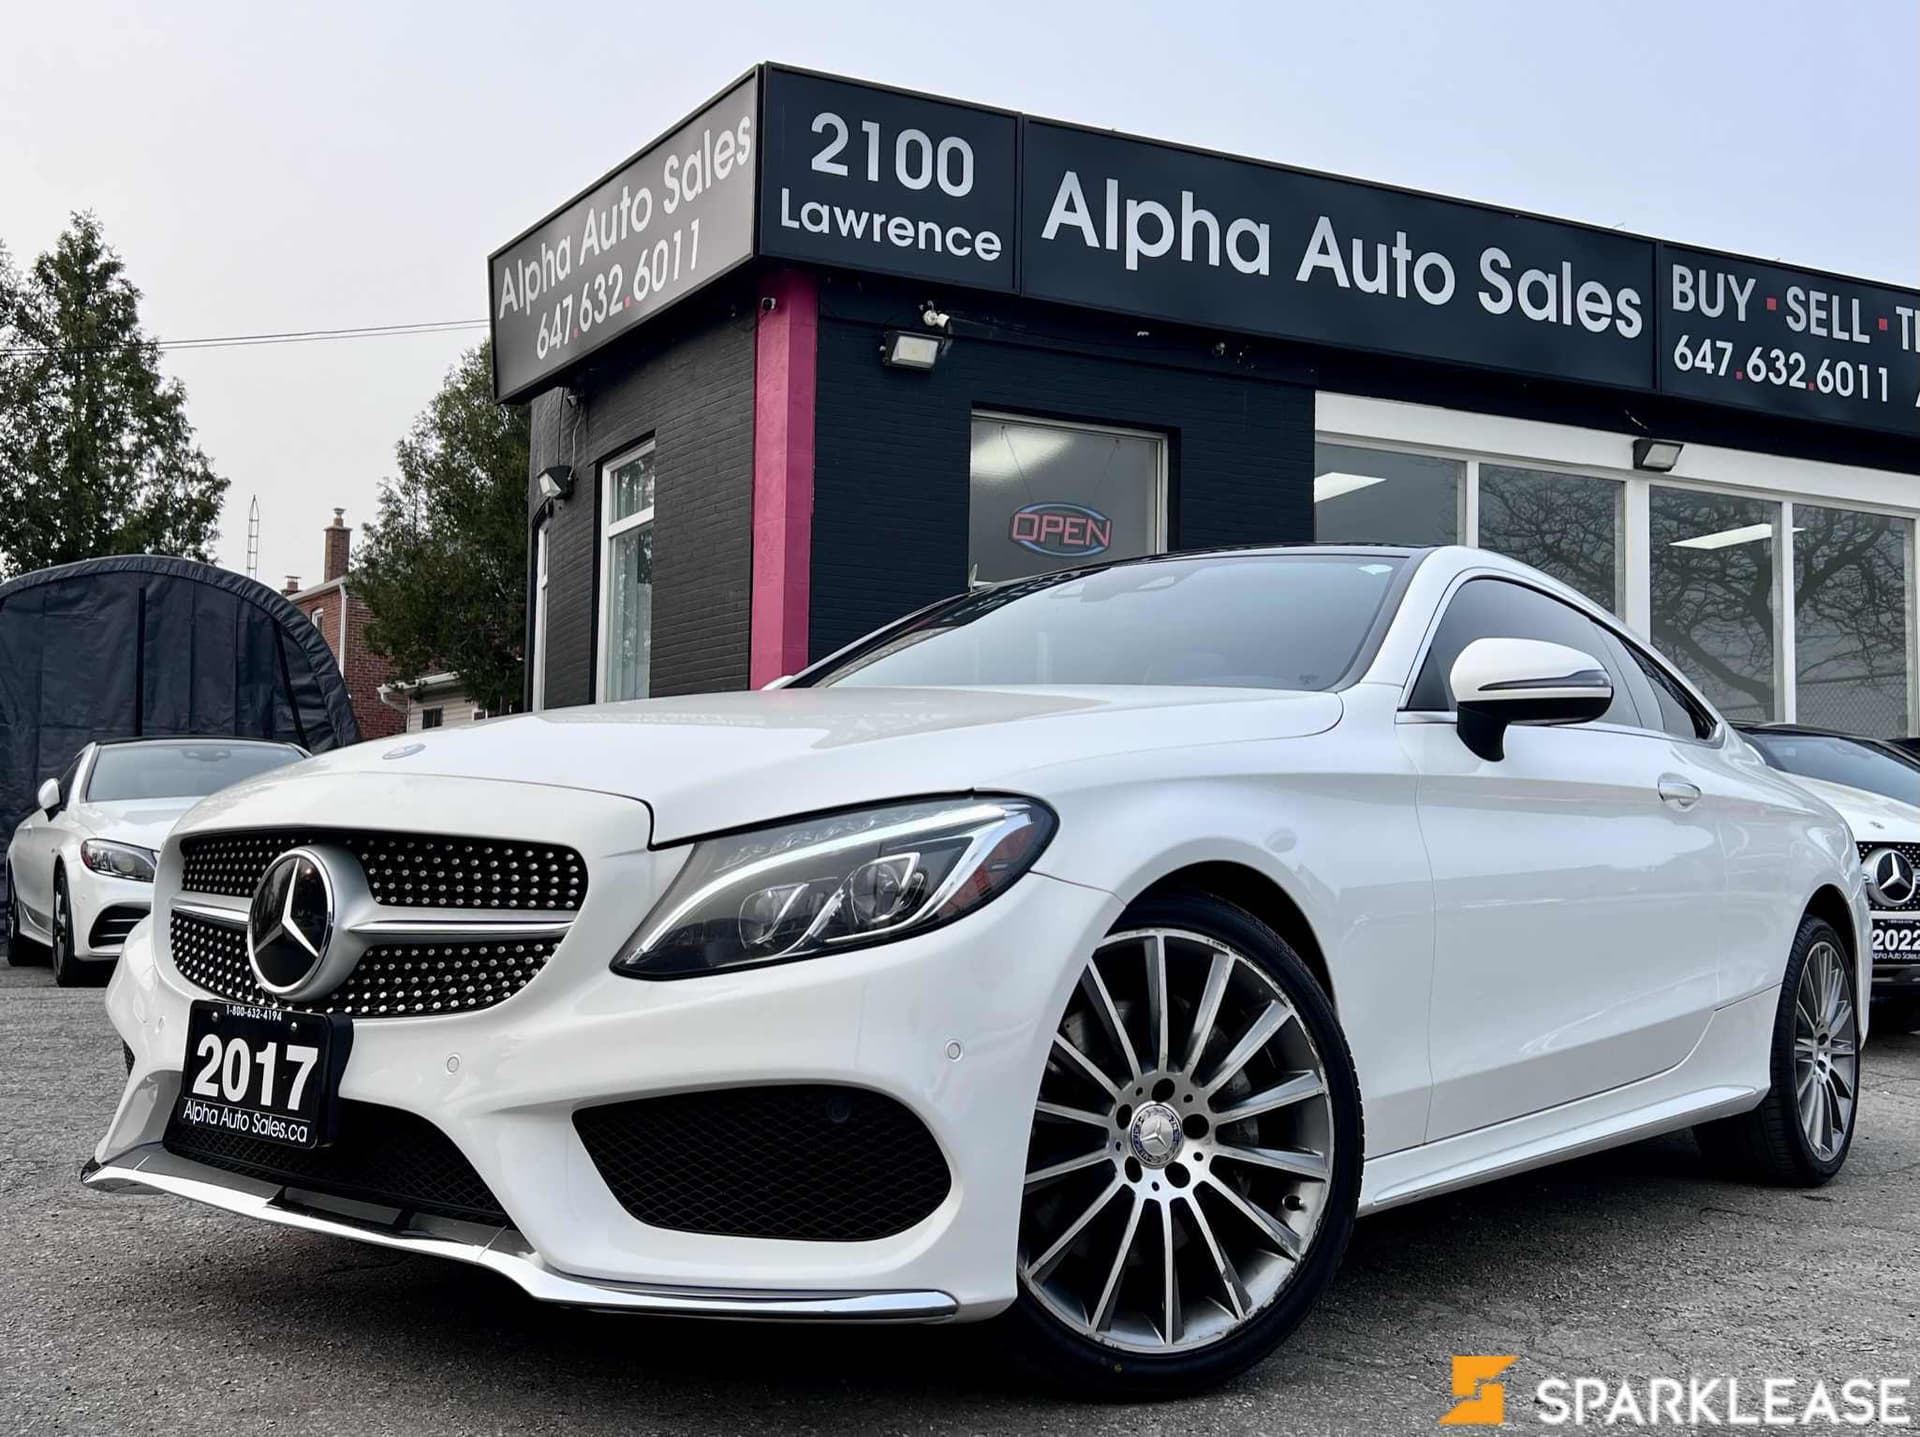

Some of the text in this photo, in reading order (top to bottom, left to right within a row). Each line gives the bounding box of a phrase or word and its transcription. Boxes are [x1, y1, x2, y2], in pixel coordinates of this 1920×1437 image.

[811, 112, 975, 197] 2100
[499, 115, 751, 320] Alpha Auto Sales
[781, 187, 1002, 261] Lawrence
[1040, 171, 1643, 339] Alpha Auto Sales
[537, 217, 700, 360] 647.632.6011
[1672, 263, 1920, 353] BUY SELL T
[1673, 334, 1888, 402] 647.632.6011
[1012, 512, 1111, 546] OPEN
[1872, 929, 1920, 951] 2022
[226, 1004, 282, 1021] 1-800-632-4194
[192, 1033, 318, 1111] 2017
[183, 1100, 308, 1142] Alpha Auto Sales.ca
